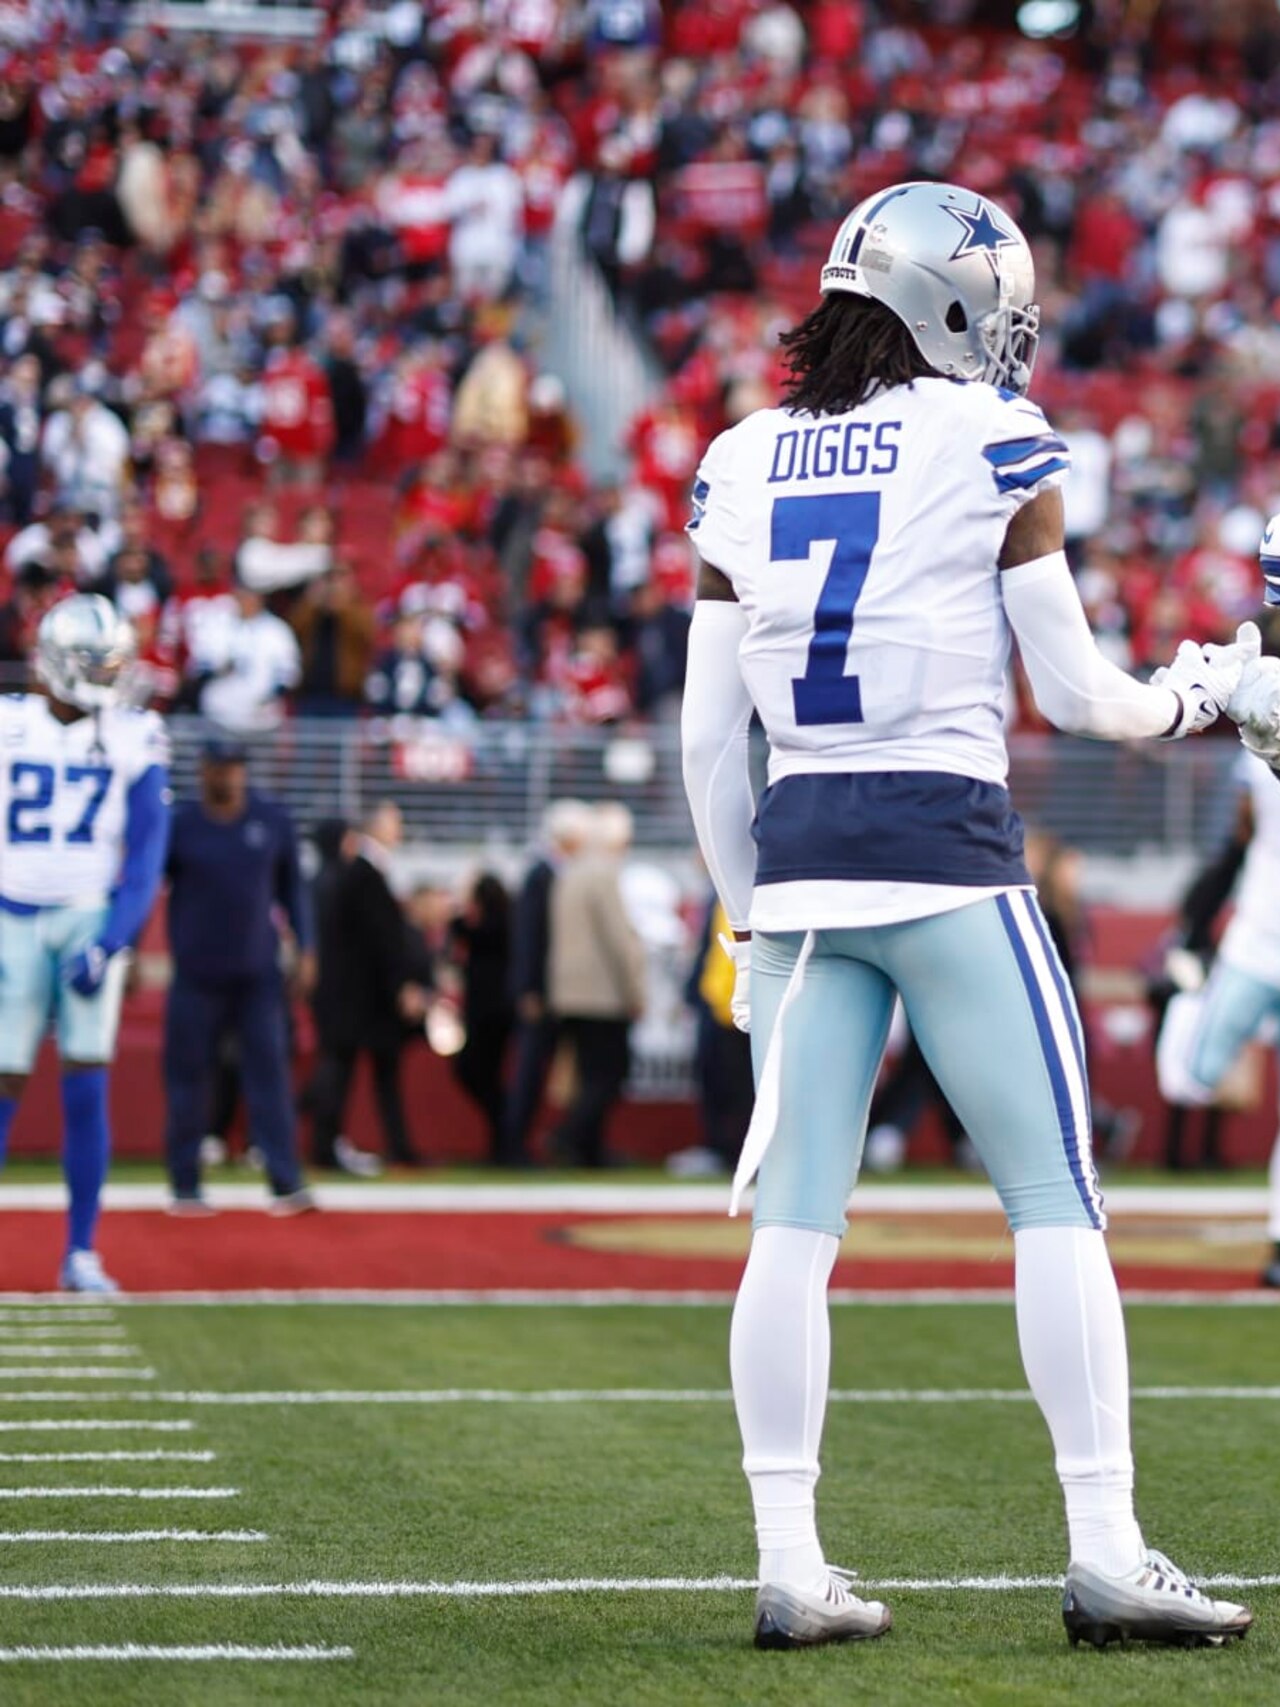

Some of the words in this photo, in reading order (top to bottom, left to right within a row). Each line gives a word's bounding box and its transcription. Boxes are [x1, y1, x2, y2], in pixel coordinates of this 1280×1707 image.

[767, 421, 902, 483] DIGGS
[769, 491, 881, 726] 7
[8, 761, 114, 844] 27
